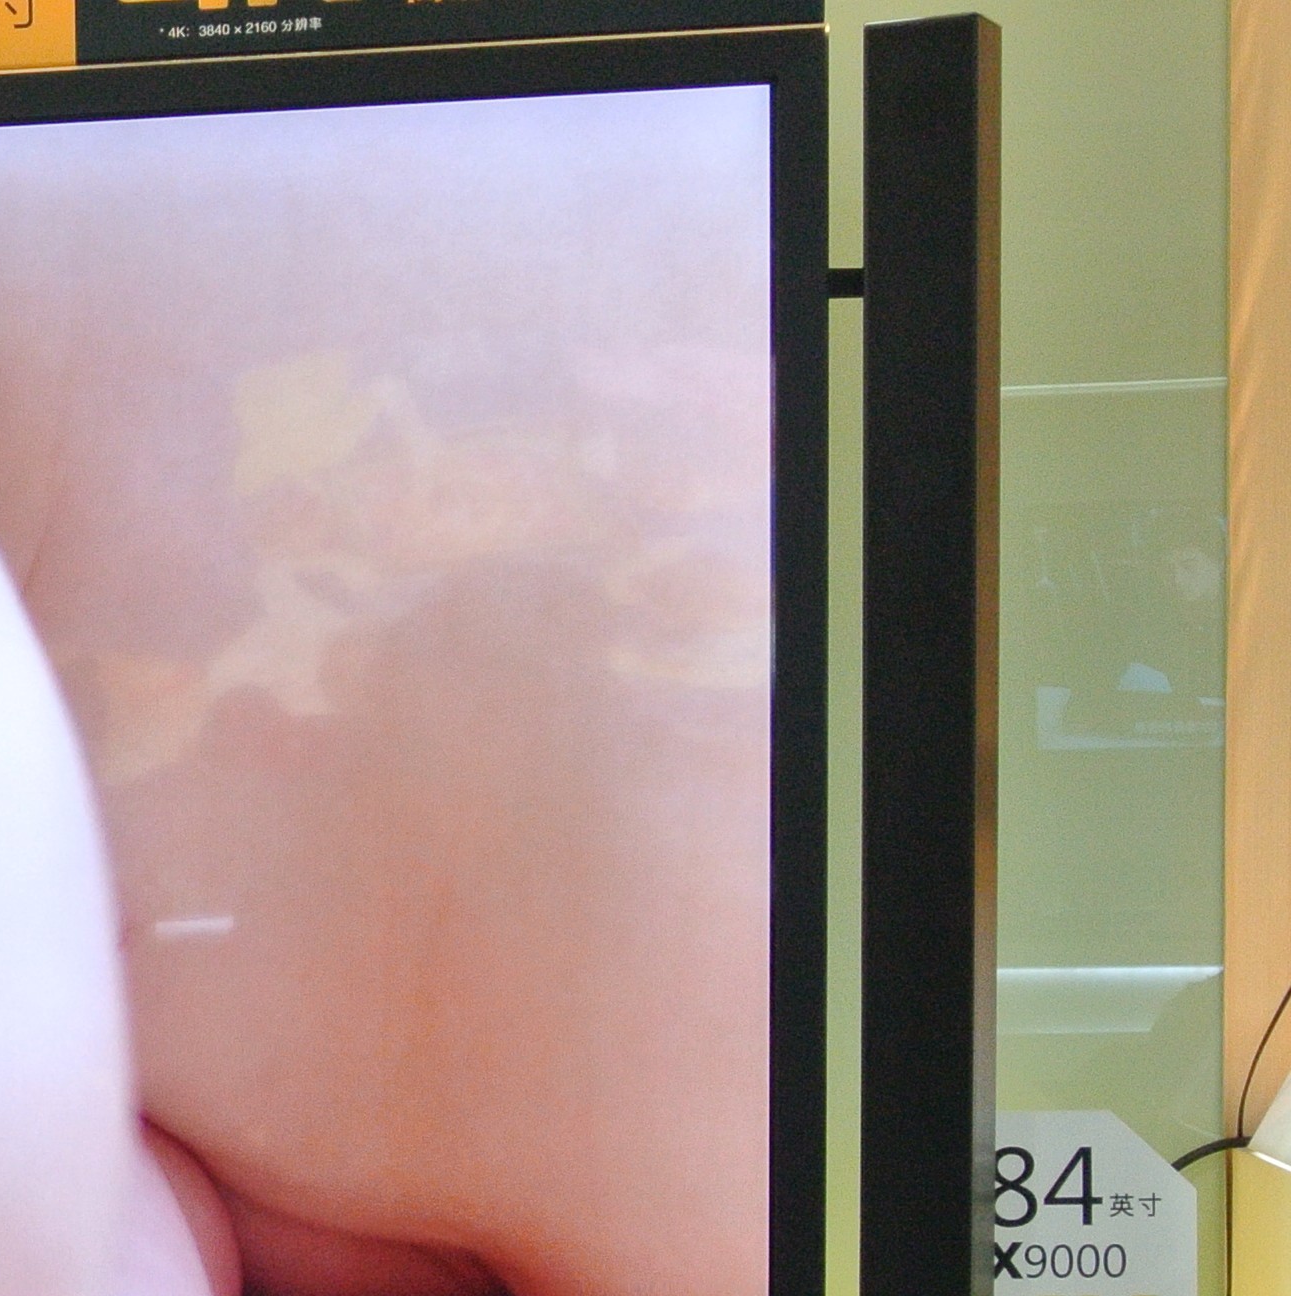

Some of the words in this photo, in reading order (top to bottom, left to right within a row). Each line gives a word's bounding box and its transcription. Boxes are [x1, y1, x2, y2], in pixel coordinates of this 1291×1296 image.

[199, 23, 230, 37] 3840
[245, 21, 277, 34] 2160
[282, 17, 322, 32] 分辨率
[994, 1146, 1103, 1228] 84
[1109, 1192, 1162, 1218] 英寸
[994, 1242, 1127, 1279] X9000
